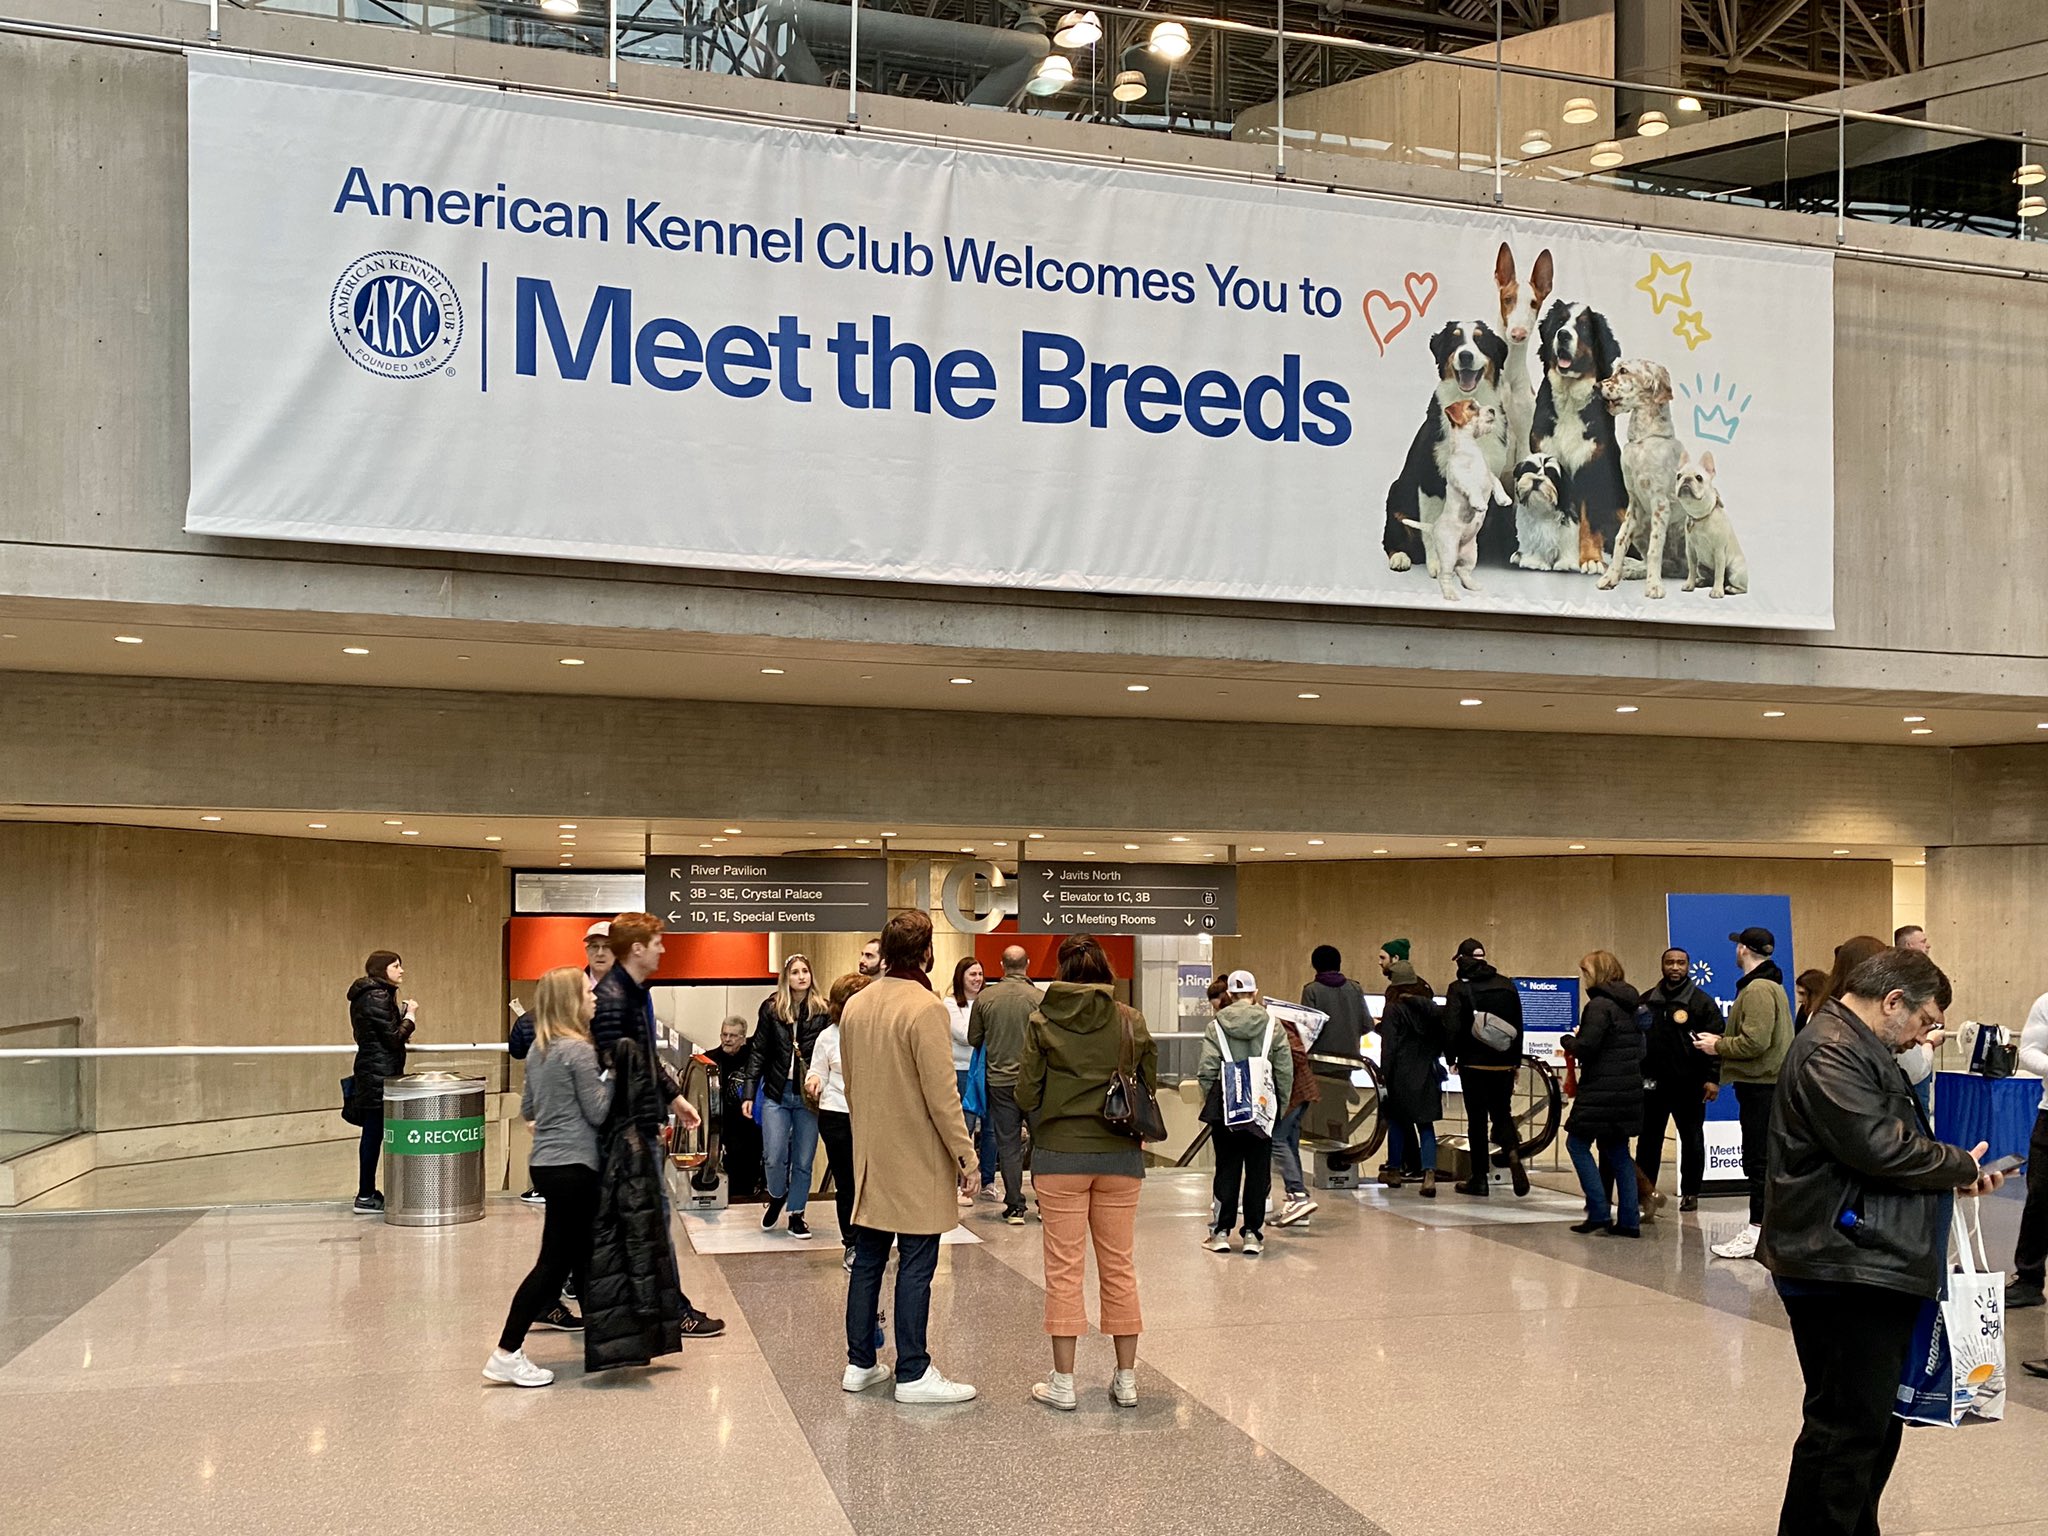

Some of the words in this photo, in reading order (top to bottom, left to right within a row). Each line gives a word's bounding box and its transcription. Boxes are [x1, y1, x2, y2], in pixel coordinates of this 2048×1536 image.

[335, 167, 609, 242] American
[627, 198, 803, 264] Kennel
[817, 223, 933, 278] Club
[945, 237, 1195, 305] Welcomes
[1207, 264, 1287, 313] You
[1300, 279, 1342, 318] to
[338, 258, 386, 319] AMERICAN
[389, 258, 442, 293] KENNEL
[439, 292, 456, 330] CLUB
[358, 278, 435, 356] AKC
[355, 348, 409, 372] FOUNDED
[413, 355, 438, 371] 1884
[515, 276, 812, 403] Meet
[827, 315, 998, 421] the
[1022, 330, 1353, 447] Breeds
[690, 864, 720, 876] River
[723, 865, 767, 876] Pavilion
[1059, 870, 1090, 881] Javits
[1092, 870, 1121, 881] North
[690, 888, 707, 899] 3B
[719, 888, 738, 900] 3E,
[741, 888, 782, 902] Crystal
[785, 888, 823, 900] Palace
[898, 859, 1006, 933] 1C
[1060, 891, 1102, 902] Elevator
[1103, 892, 1115, 902] to
[1116, 892, 1133, 903] 1C,
[1135, 892, 1151, 903] 3B
[690, 911, 709, 923] 1D,
[712, 911, 730, 923] 1E,
[732, 911, 775, 924] Special
[778, 911, 816, 922] Events
[1060, 913, 1074, 924] 1C
[1076, 913, 1118, 927] Meeting
[1120, 914, 1157, 925] Rooms
[1529, 981, 1558, 991] Notice:
[424, 1127, 479, 1144] RECYCLE
[1710, 1145, 1736, 1156] Meet
